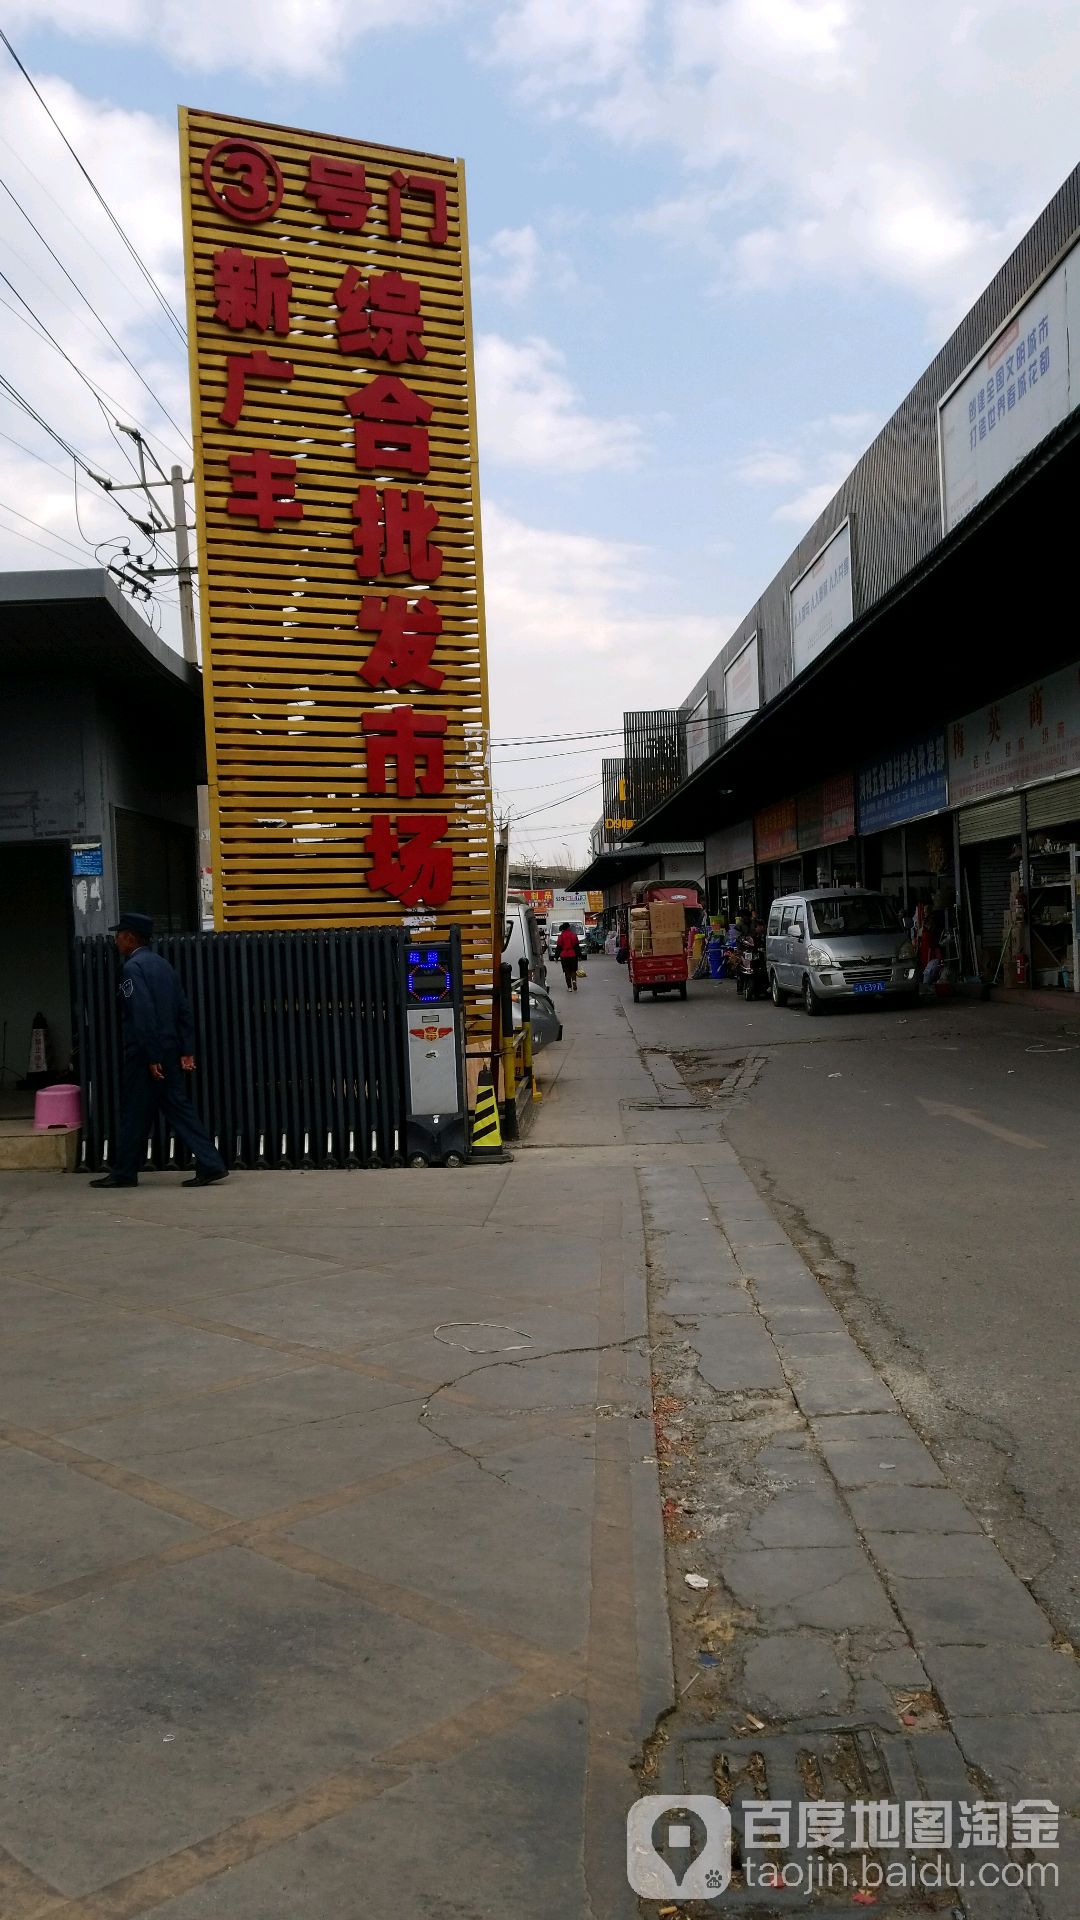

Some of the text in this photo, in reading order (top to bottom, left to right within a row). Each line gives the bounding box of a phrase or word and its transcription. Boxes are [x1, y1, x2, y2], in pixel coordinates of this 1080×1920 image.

[212, 248, 303, 531] 新广丰
[968, 315, 1049, 421] 创建全国文明城市
[969, 350, 1051, 452] 打造世界春城花都
[333, 265, 453, 907] 综合批发市场
